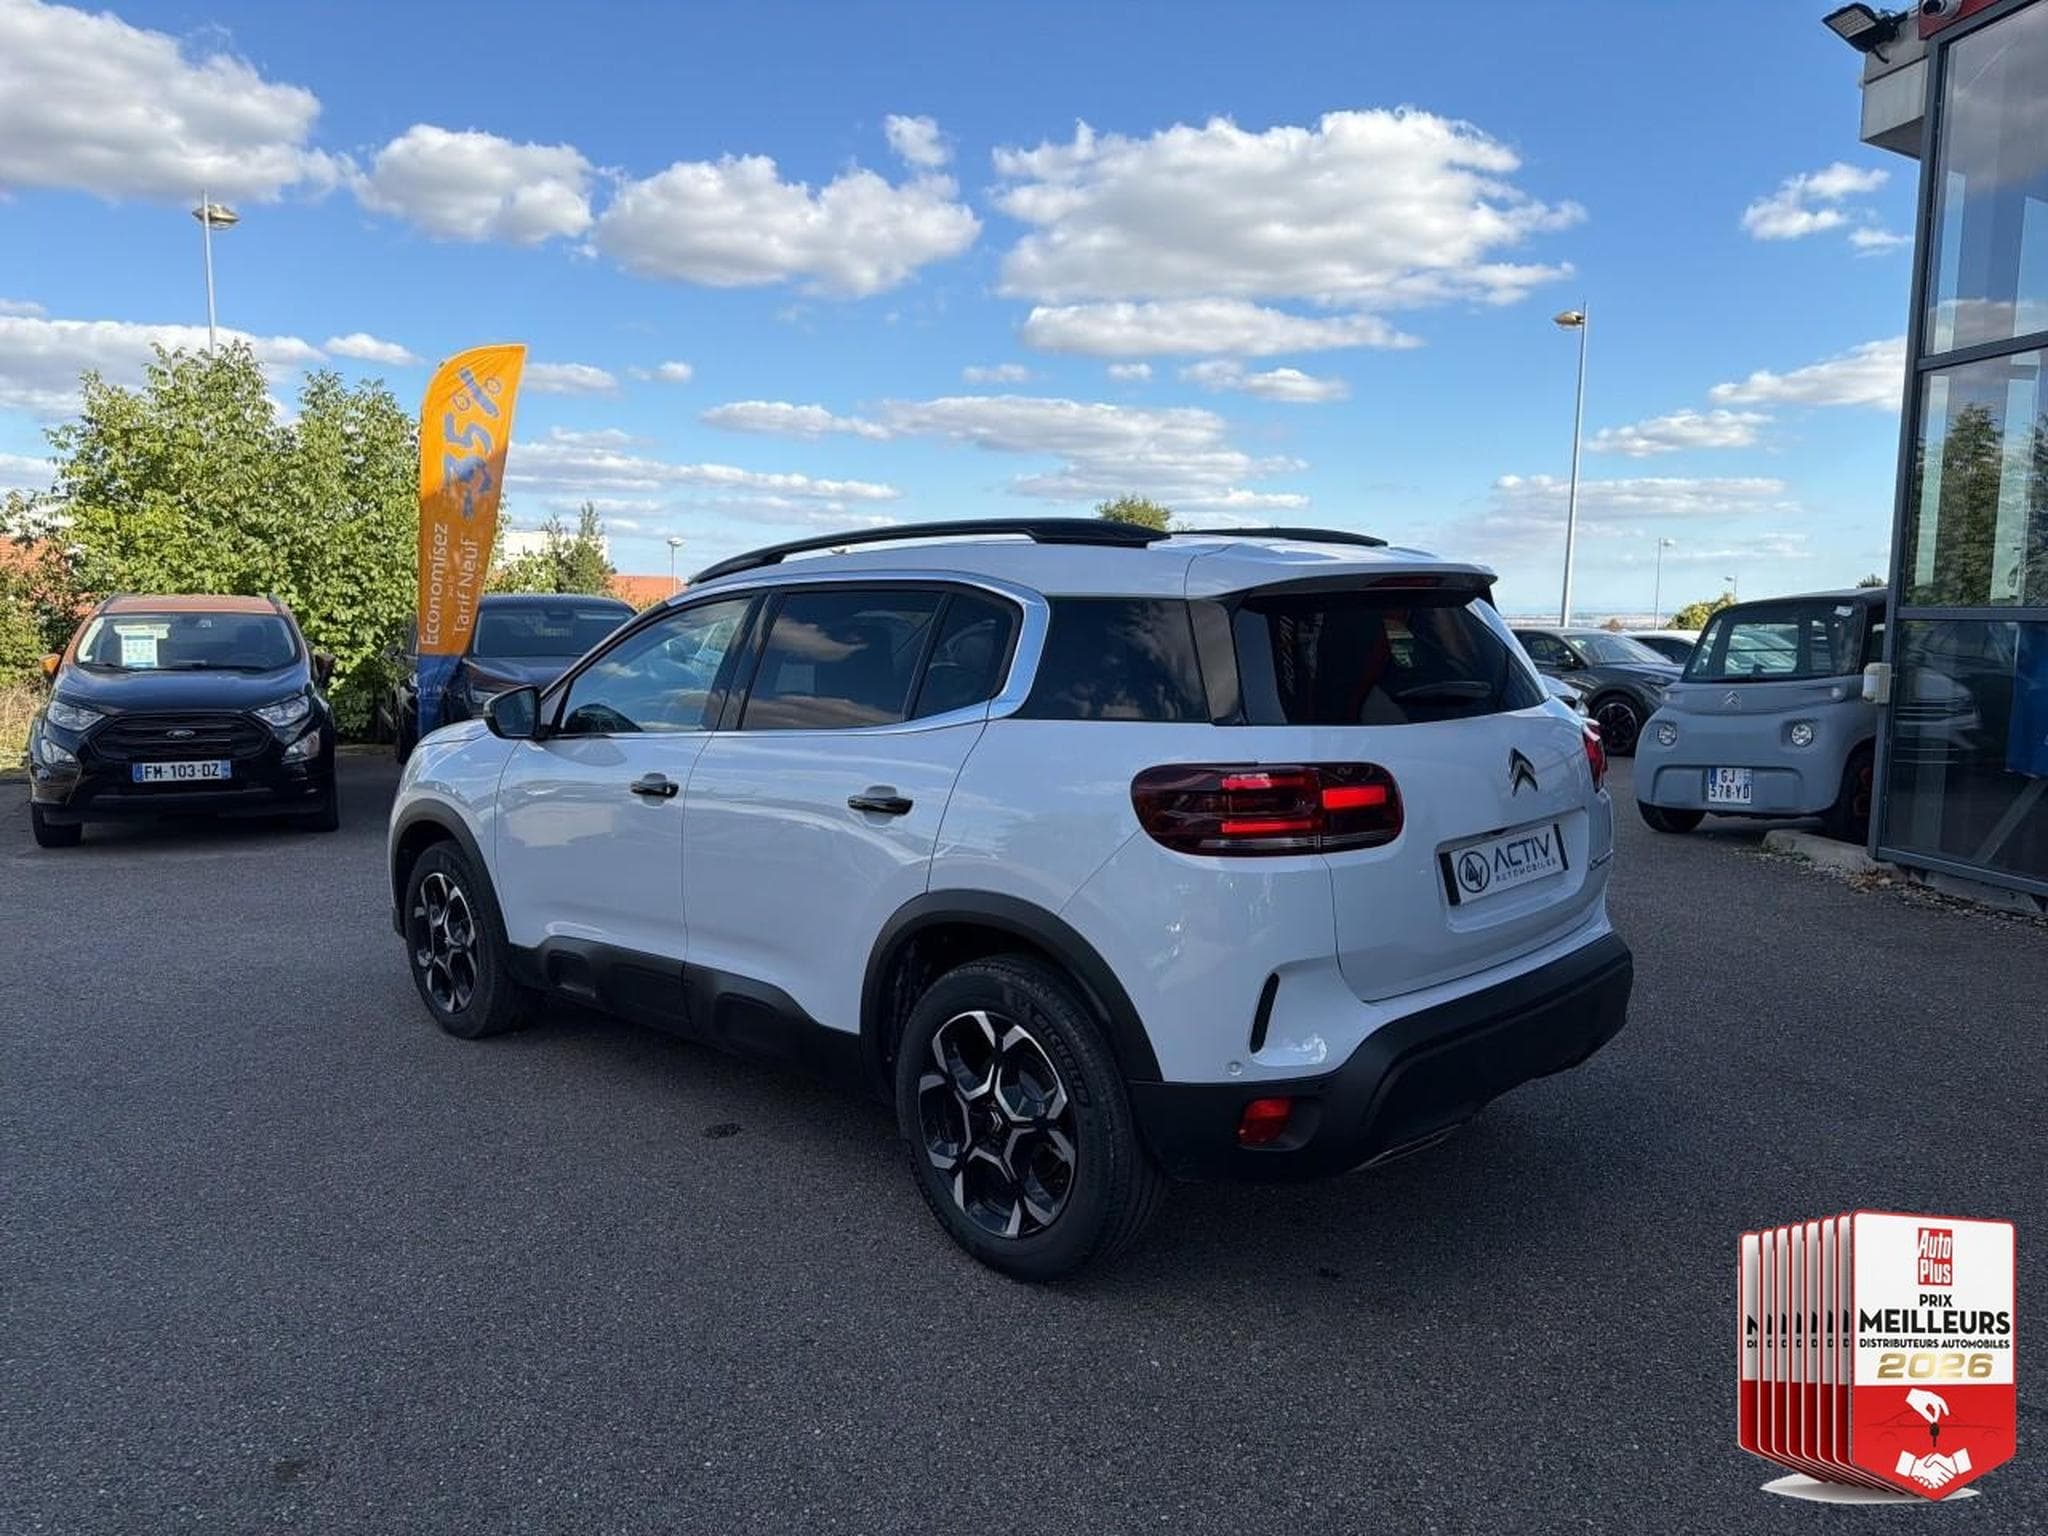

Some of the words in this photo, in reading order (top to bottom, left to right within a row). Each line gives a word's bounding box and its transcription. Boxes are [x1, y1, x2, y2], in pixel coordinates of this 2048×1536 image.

[459, 536, 479, 587] Neuf
[453, 590, 471, 636] Tarif
[1720, 769, 1736, 783] GJ
[1494, 833, 1550, 873] ACTIV
